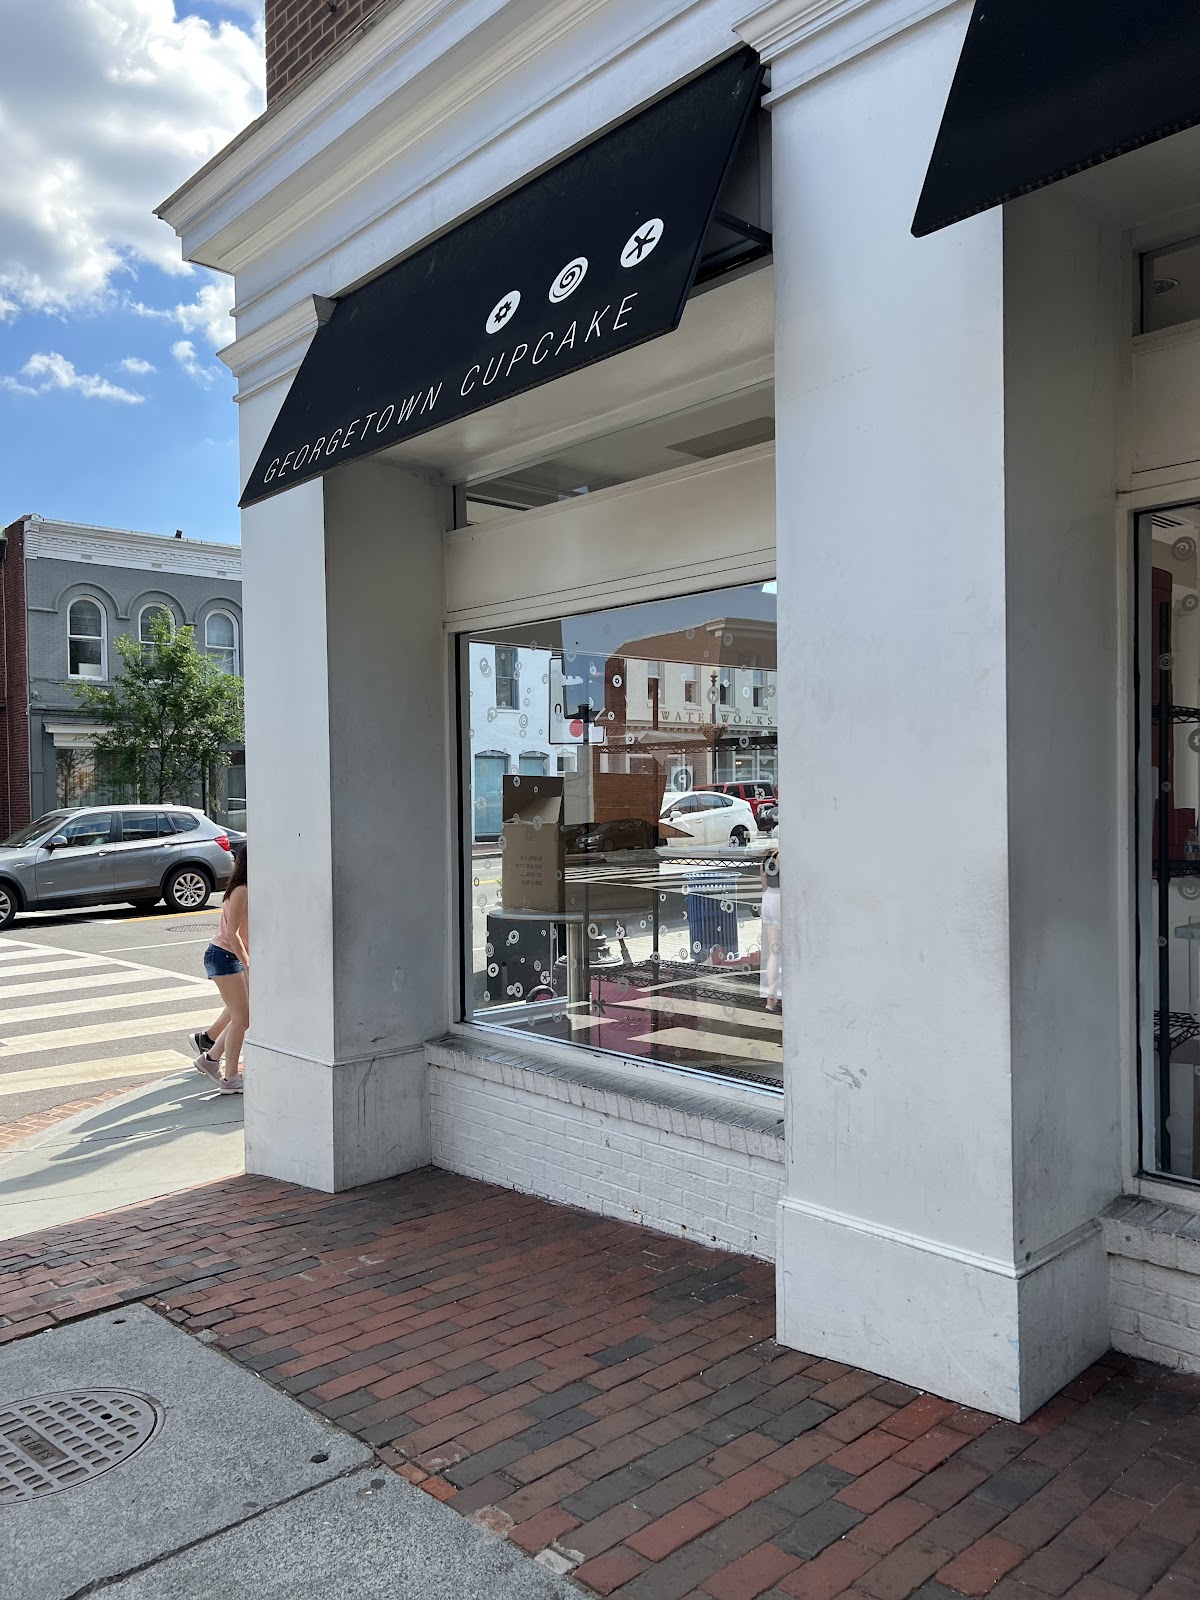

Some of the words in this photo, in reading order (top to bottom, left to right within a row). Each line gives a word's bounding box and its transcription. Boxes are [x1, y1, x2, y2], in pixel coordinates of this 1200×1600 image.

[263, 381, 443, 484] GEORGETOWN
[460, 292, 638, 396] CUPCAKE
[721, 713, 773, 726] WORKS
